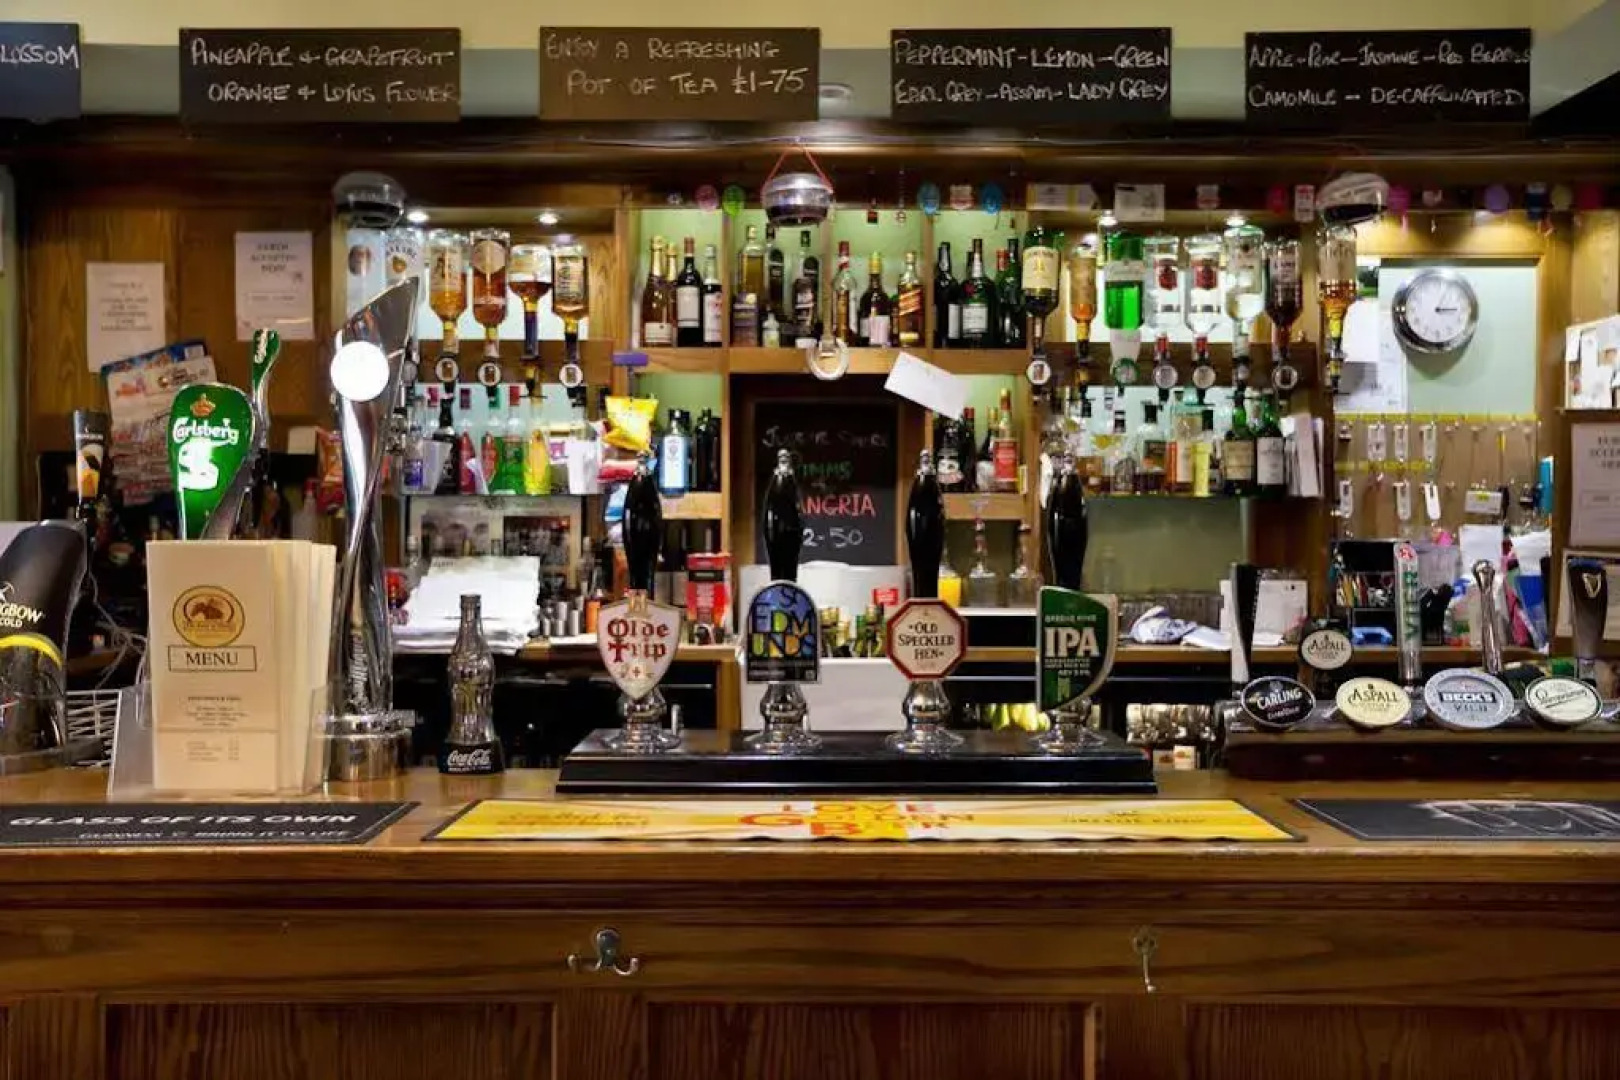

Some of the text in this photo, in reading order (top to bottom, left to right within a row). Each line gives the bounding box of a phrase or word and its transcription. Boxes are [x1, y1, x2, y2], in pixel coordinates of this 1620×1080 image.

[191, 39, 293, 68] PINEAPPLE
[324, 45, 455, 67] GRAPEFRUIT
[615, 41, 630, 59] A
[648, 38, 780, 60] REFRESHING
[208, 82, 291, 102] ORANGE
[323, 82, 375, 103] LOTUS
[567, 69, 611, 95] POT
[630, 78, 656, 95] OF
[670, 72, 718, 95] TEA
[173, 417, 240, 445] Carlsberg
[798, 494, 876, 517] NGRIA
[0, 603, 43, 624] GBOW
[898, 634, 955, 647] SPECKLED
[1044, 626, 1100, 658] IPA
[186, 652, 239, 665] MENU
[1257, 687, 1303, 710] CARLING
[1347, 688, 1398, 704] ASPALL
[9, 814, 357, 827] GLASS OF ITS OWN
